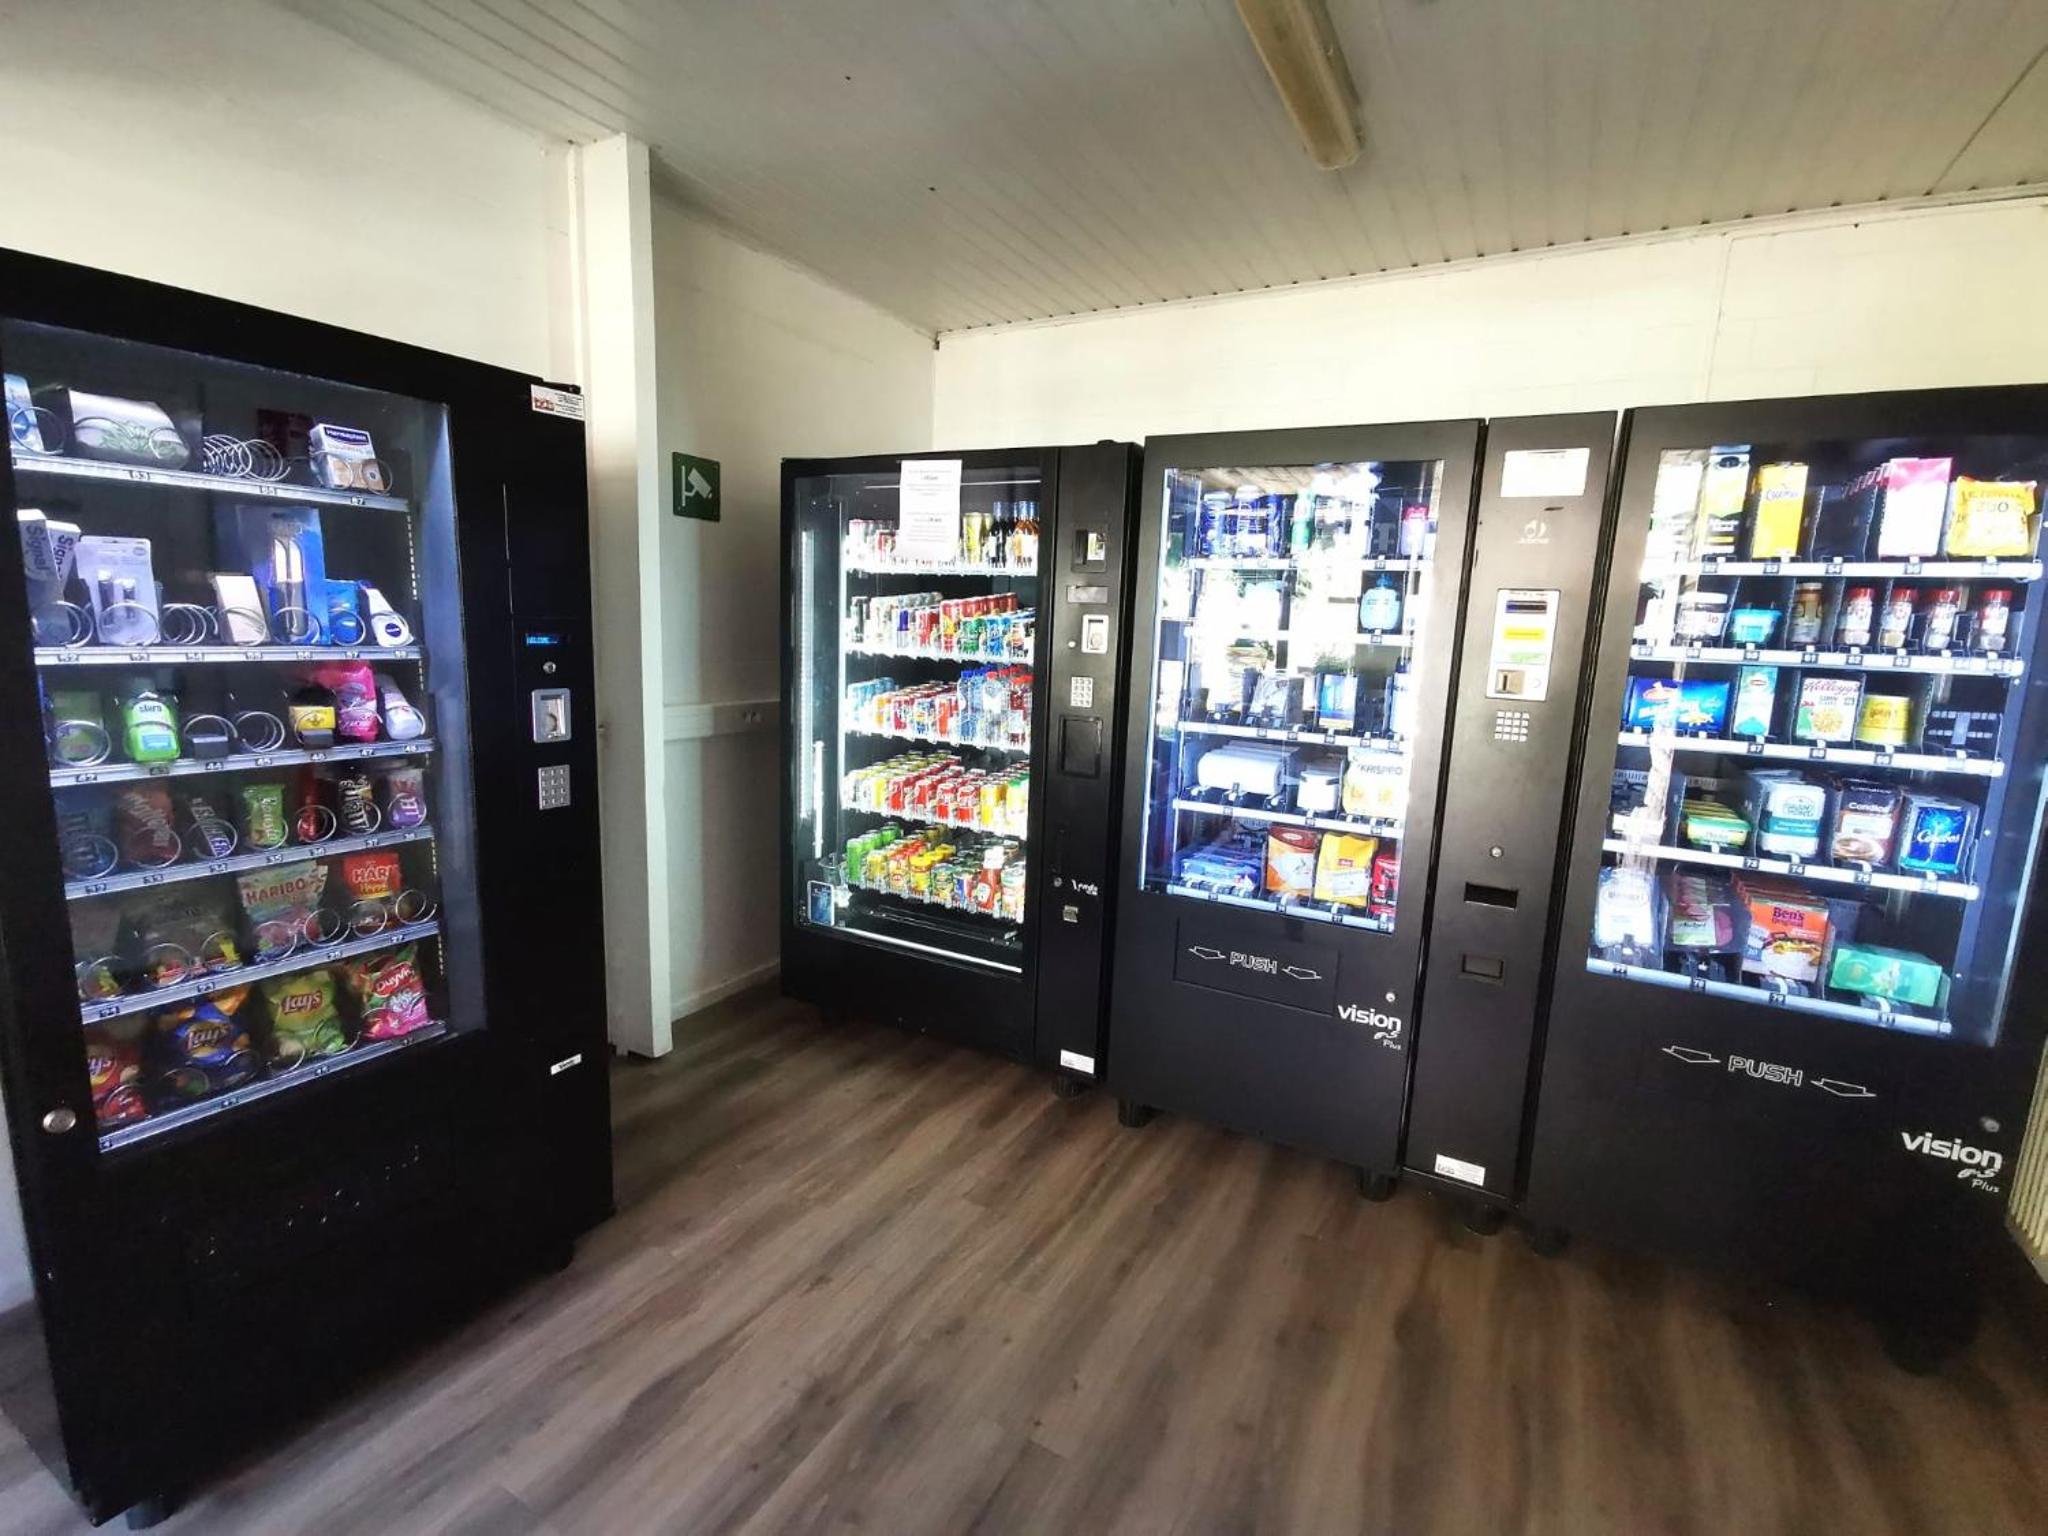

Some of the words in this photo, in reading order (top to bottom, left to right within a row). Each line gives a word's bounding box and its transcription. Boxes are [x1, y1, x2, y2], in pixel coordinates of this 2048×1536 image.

[25, 525, 50, 571] Signal
[244, 877, 306, 904] HARIBO
[1773, 907, 1804, 921] Ben's
[1230, 951, 1277, 975] PUSH
[1337, 1004, 1401, 1032] vision
[1728, 1055, 1803, 1086] PUSH
[1901, 1131, 2003, 1171] vision
[1971, 1178, 2000, 1193] Plus
